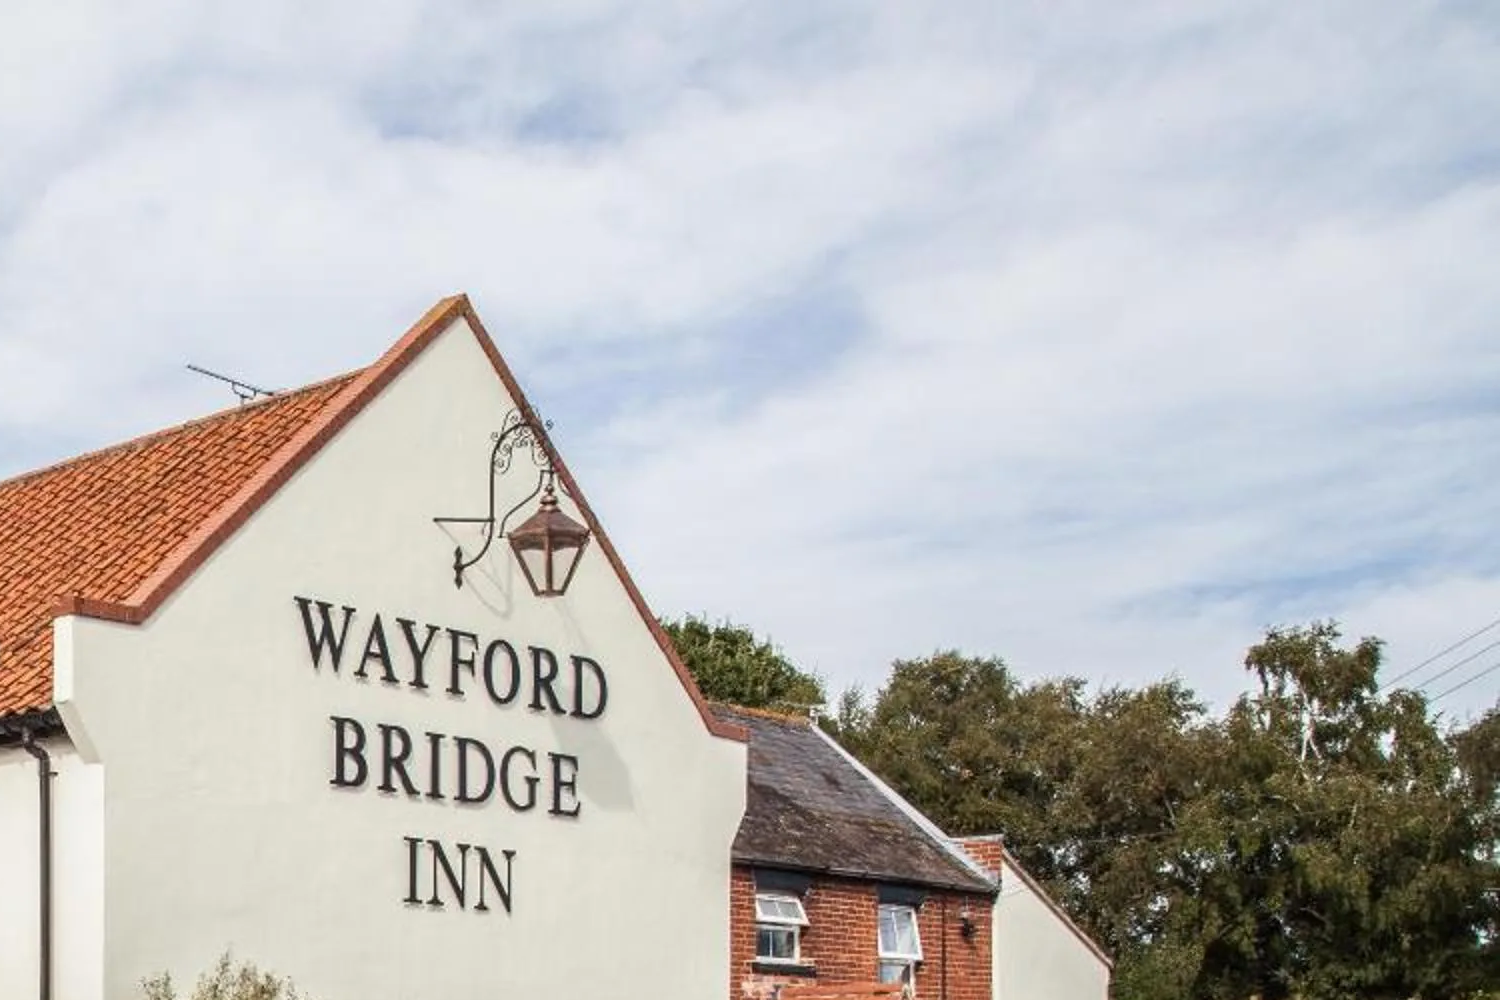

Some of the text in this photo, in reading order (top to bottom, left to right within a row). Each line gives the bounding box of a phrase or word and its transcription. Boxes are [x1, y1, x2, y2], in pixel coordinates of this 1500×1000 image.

[293, 595, 608, 720] WAYFORD
[329, 715, 581, 818] BRIDGE
[403, 836, 517, 914] INN
